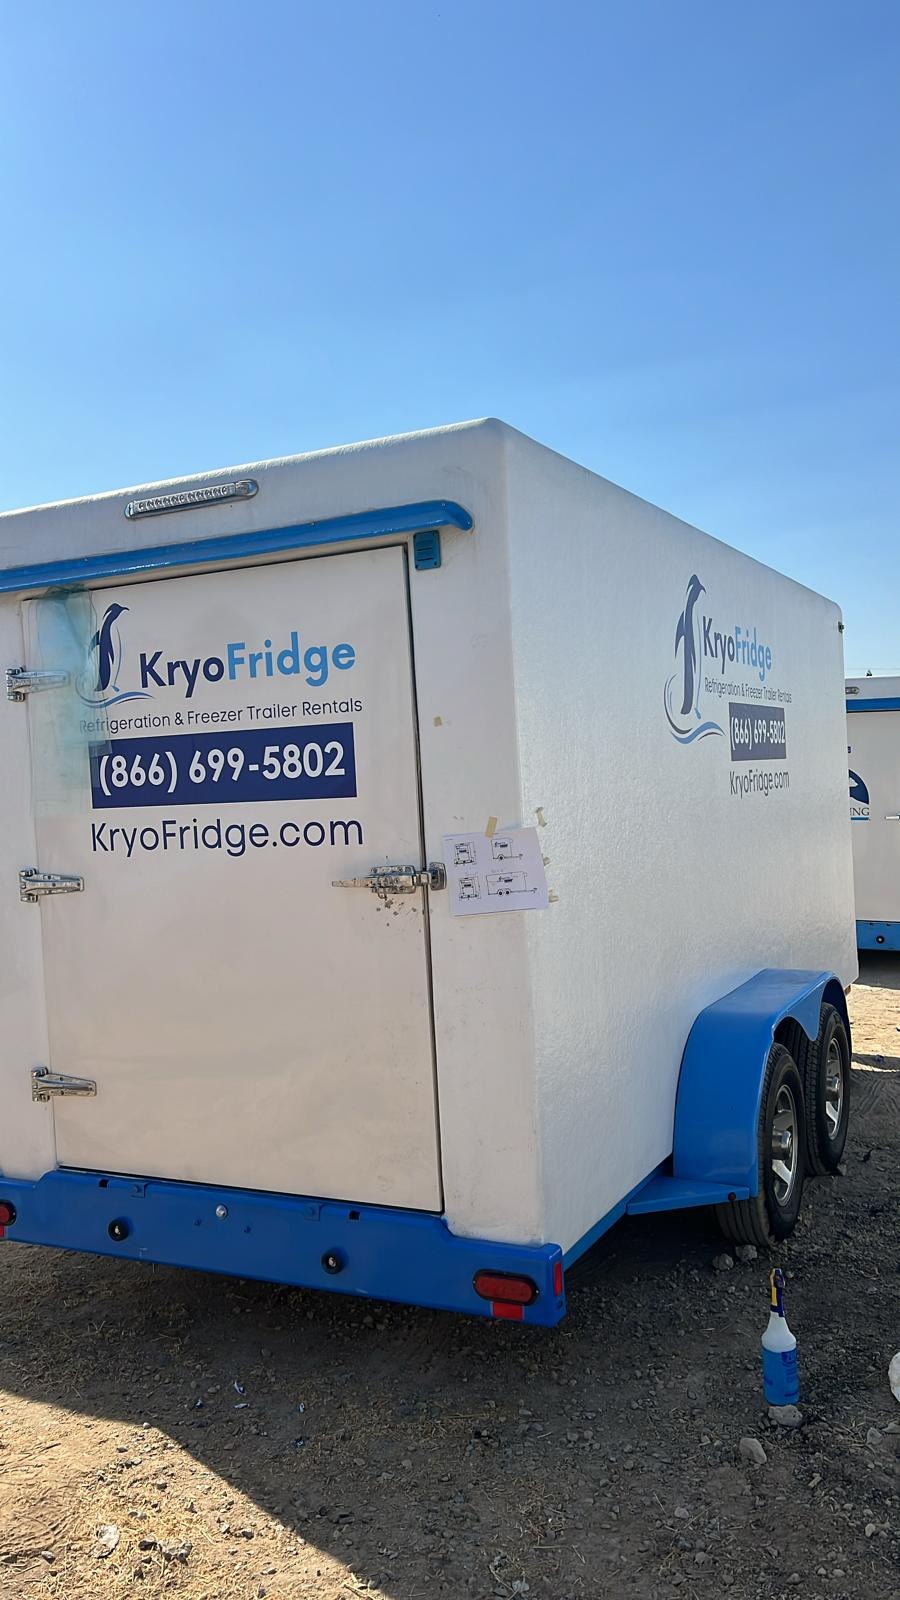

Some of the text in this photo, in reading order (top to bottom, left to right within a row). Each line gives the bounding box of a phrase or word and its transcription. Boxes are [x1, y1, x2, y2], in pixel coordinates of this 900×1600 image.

[139, 631, 356, 698] KryoFridge
[703, 616, 772, 681] KryoFridge
[704, 677, 741, 698] Refrigeration
[745, 683, 763, 699] Freezer
[763, 686, 777, 700] Trailer
[777, 688, 792, 703] Rentals
[80, 698, 363, 734] Refrigeration & Freezer Trailer Rentals
[731, 717, 785, 750] (866) 699-5802
[100, 741, 346, 796] (866) 699-5802
[729, 769, 790, 799] KryoFridge.com
[91, 818, 364, 857] KryoFridge.com
